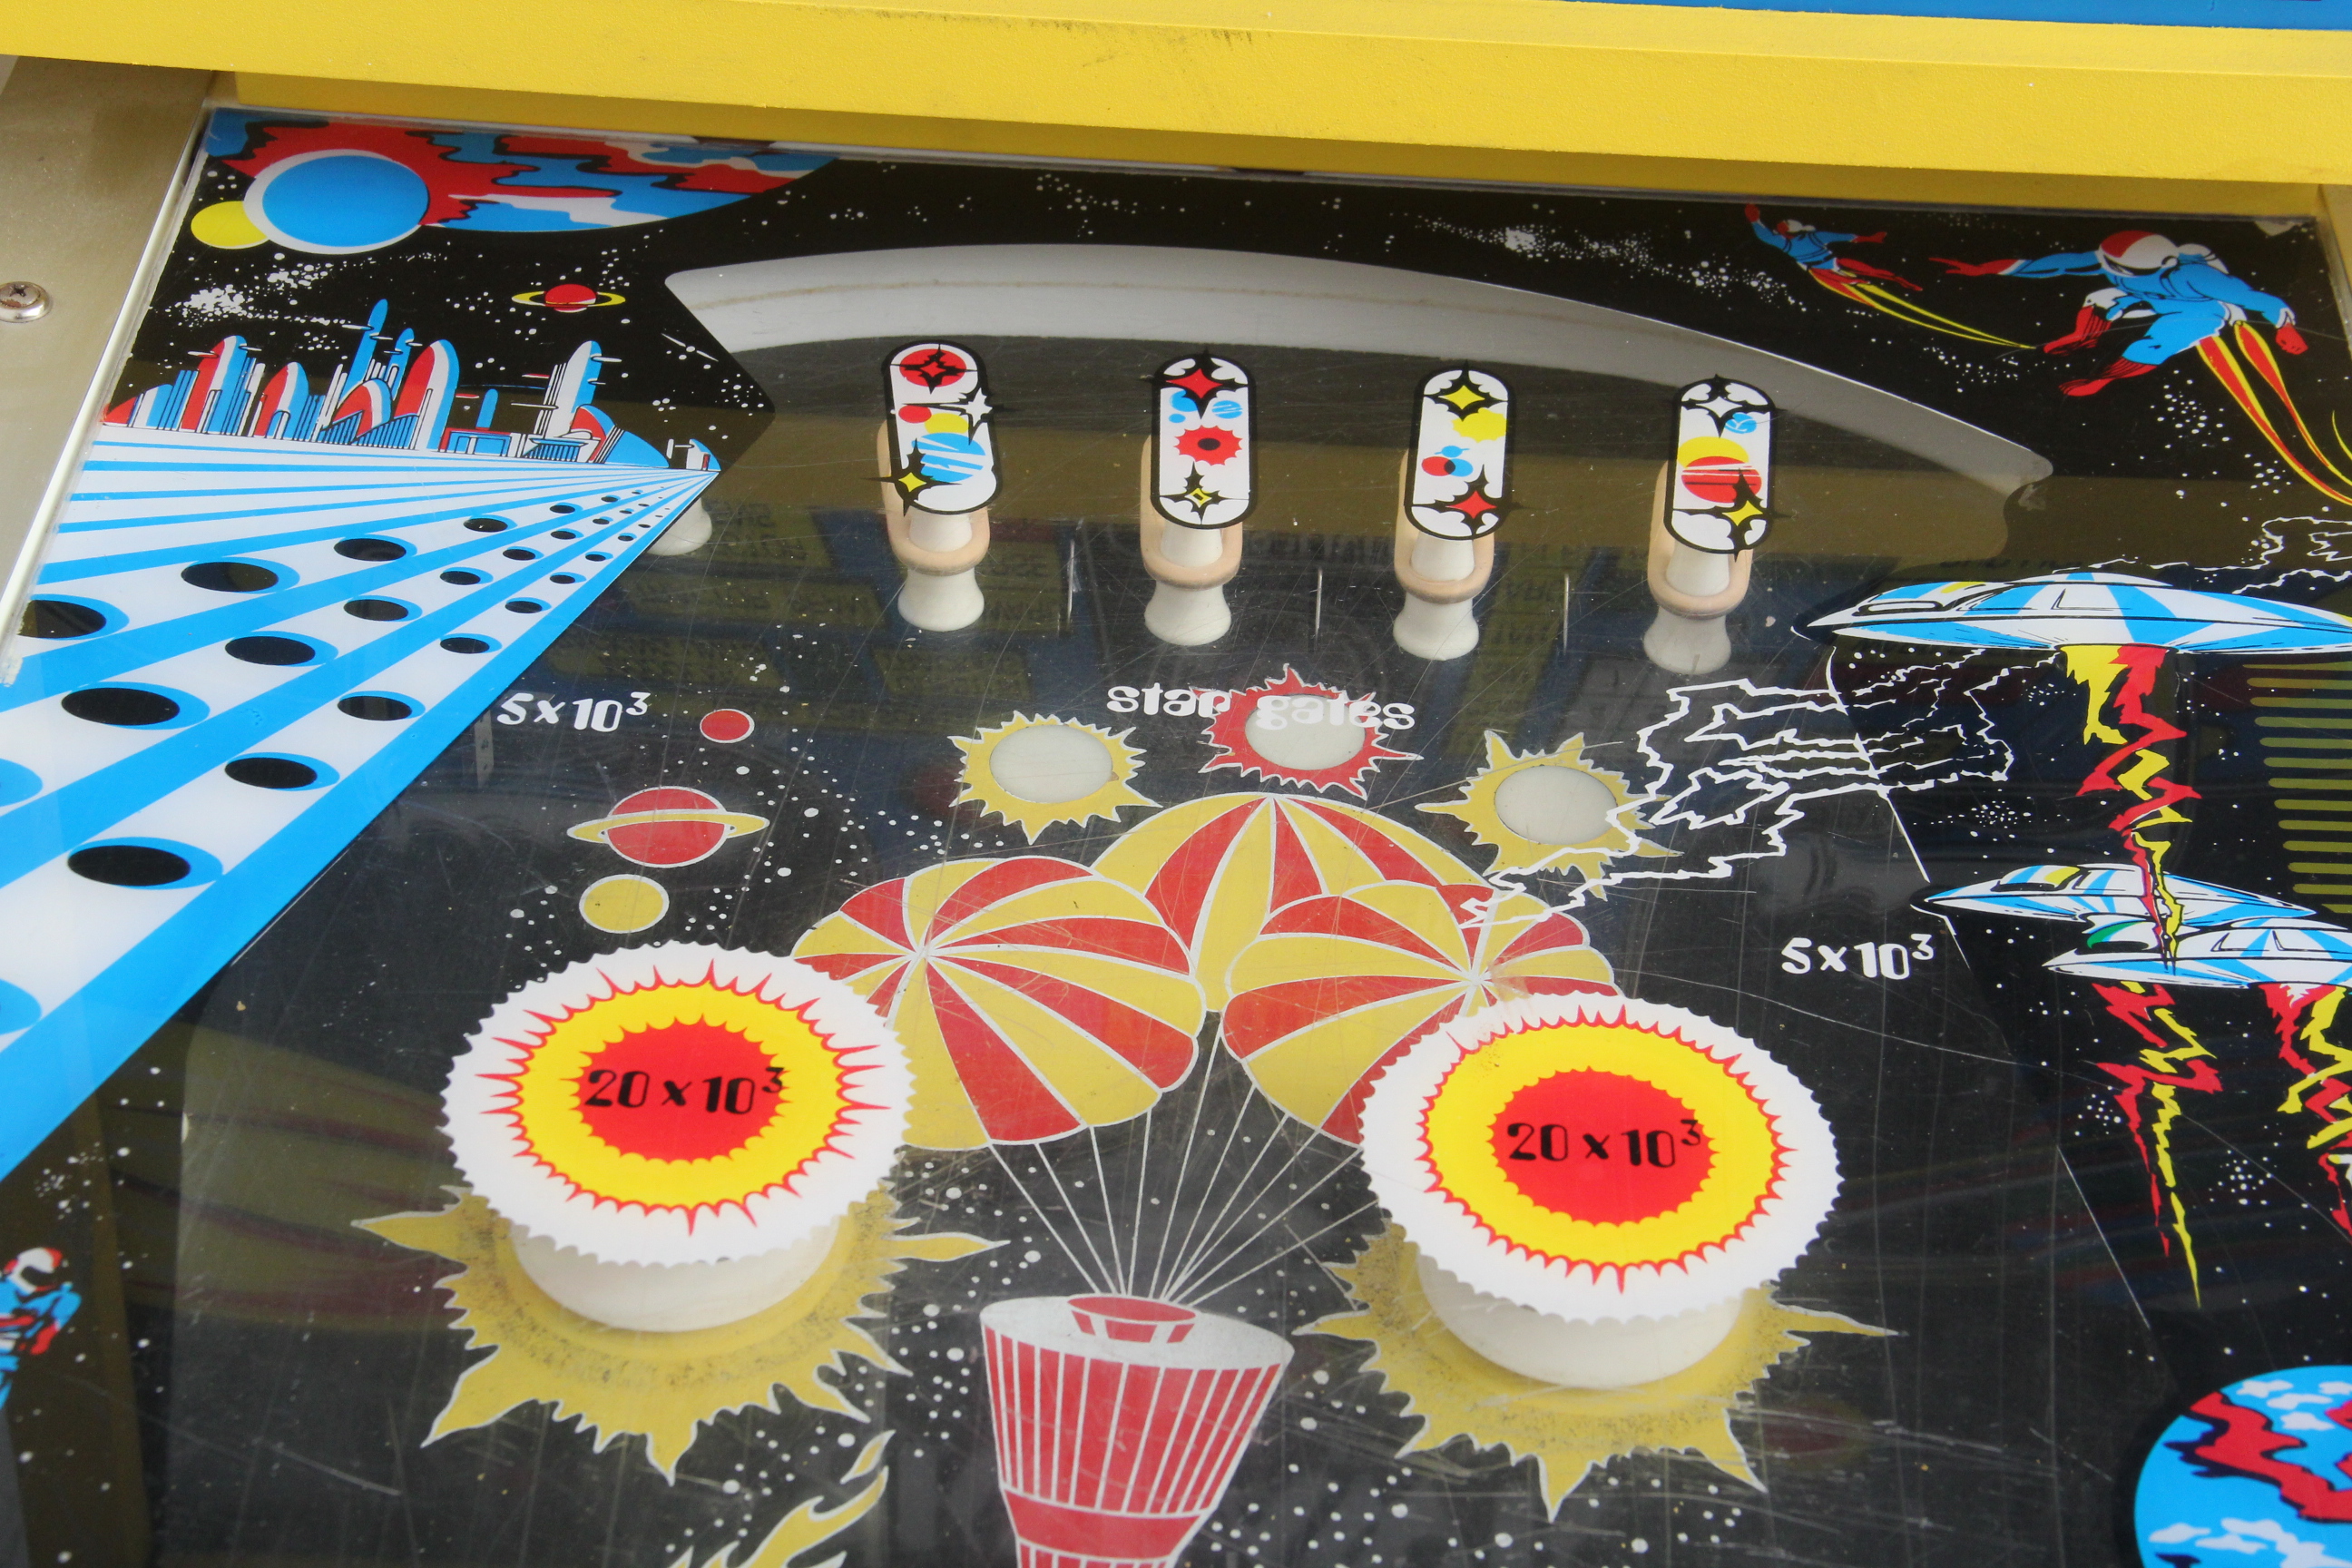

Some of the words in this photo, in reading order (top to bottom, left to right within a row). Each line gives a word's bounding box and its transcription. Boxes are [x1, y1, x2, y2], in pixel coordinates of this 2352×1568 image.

[1105, 681, 1231, 719] star
[1255, 694, 1416, 730] gates
[583, 1068, 651, 1109] 20
[1506, 1122, 1569, 1162] 20
